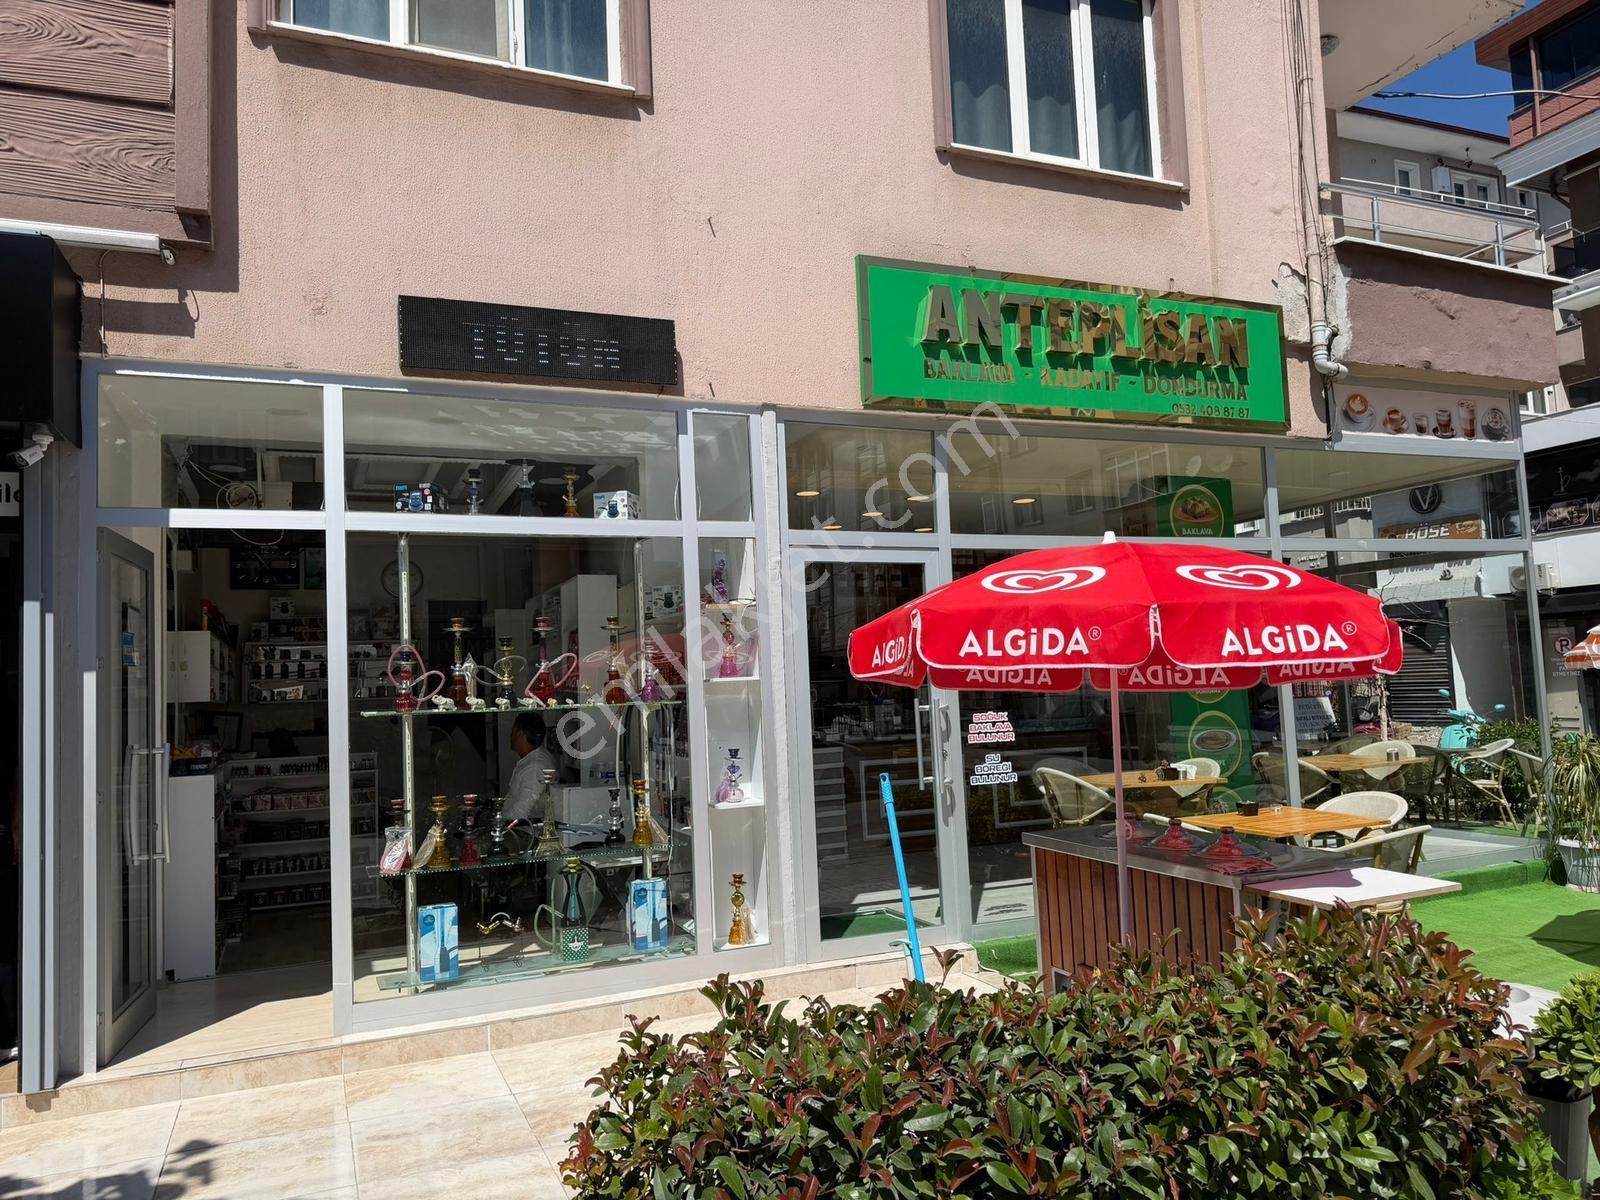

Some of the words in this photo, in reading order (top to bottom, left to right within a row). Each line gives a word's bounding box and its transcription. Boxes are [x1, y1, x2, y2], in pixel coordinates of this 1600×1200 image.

[923, 357, 1016, 384] BAKLAVA
[1040, 367, 1120, 392] KADAYIF
[1143, 374, 1249, 401] DONDURMA
[1223, 406, 1235, 417] 87
[1238, 407, 1250, 419] 87
[1182, 527, 1213, 536] BAKLAVA
[973, 711, 1008, 722] SOĞUK
[969, 723, 1013, 733] BAKLAVA
[968, 733, 1015, 743] BULUNUR
[985, 754, 1000, 762] SU
[970, 774, 1017, 785] BULUNUR
